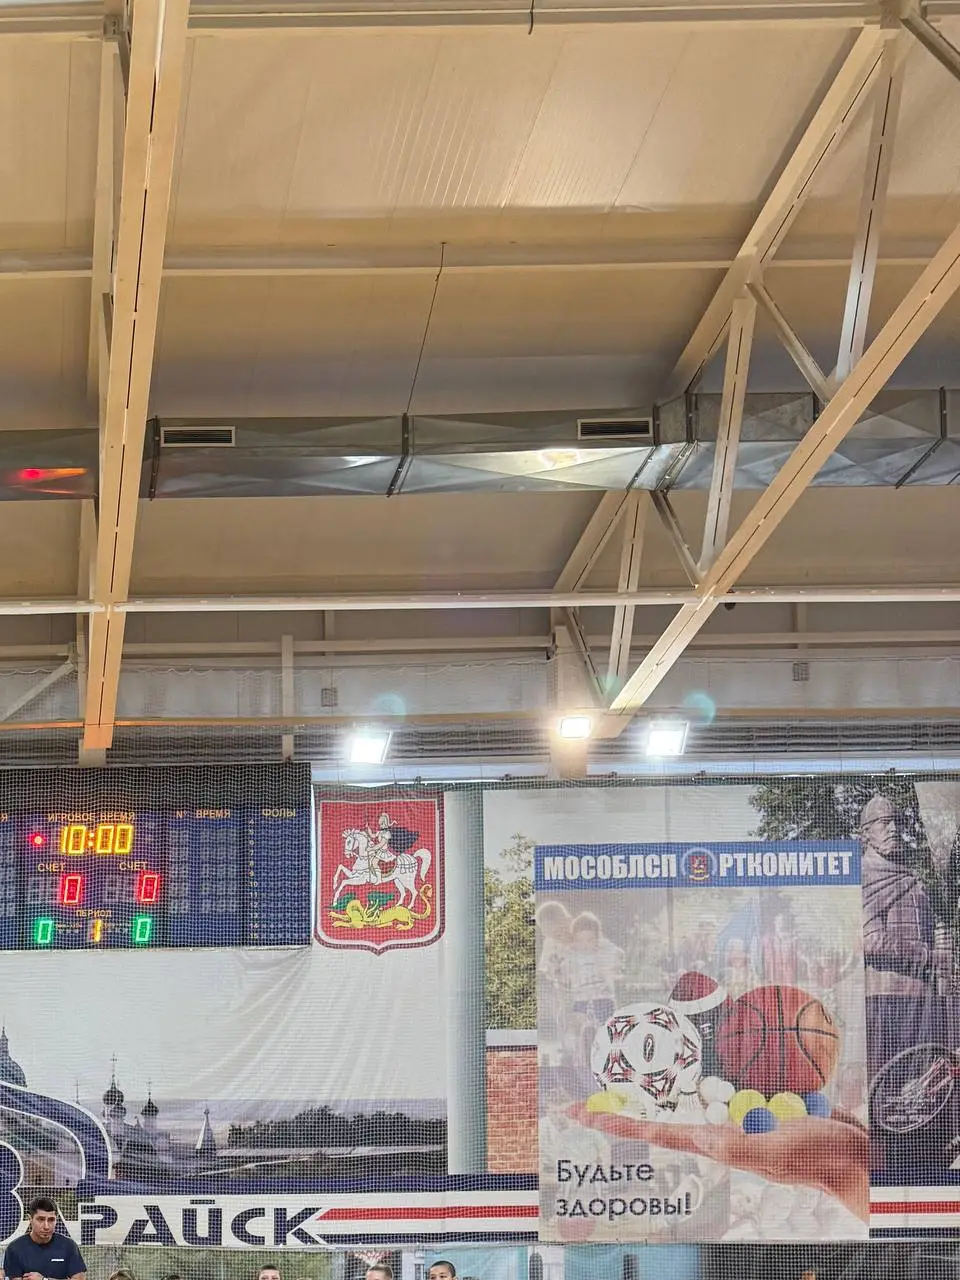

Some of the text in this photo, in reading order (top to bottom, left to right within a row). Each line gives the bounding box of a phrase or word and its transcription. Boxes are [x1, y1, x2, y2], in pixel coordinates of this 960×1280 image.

[47, 812, 135, 822] ИГРОВОЕ ВРЕМЯ
[196, 809, 231, 819] ВРЕМЯ
[262, 808, 296, 817] ФОЛЫ
[61, 825, 133, 854] 10:00
[37, 863, 65, 872] СЧЕТ
[119, 862, 148, 870] СЧЕТ
[64, 876, 81, 904] 0
[141, 874, 158, 902] 0
[38, 920, 53, 943] 0
[94, 919, 102, 942] 1
[135, 918, 151, 941] 0
[557, 1159, 655, 1187] Будьте
[555, 1192, 692, 1221] здоровы!
